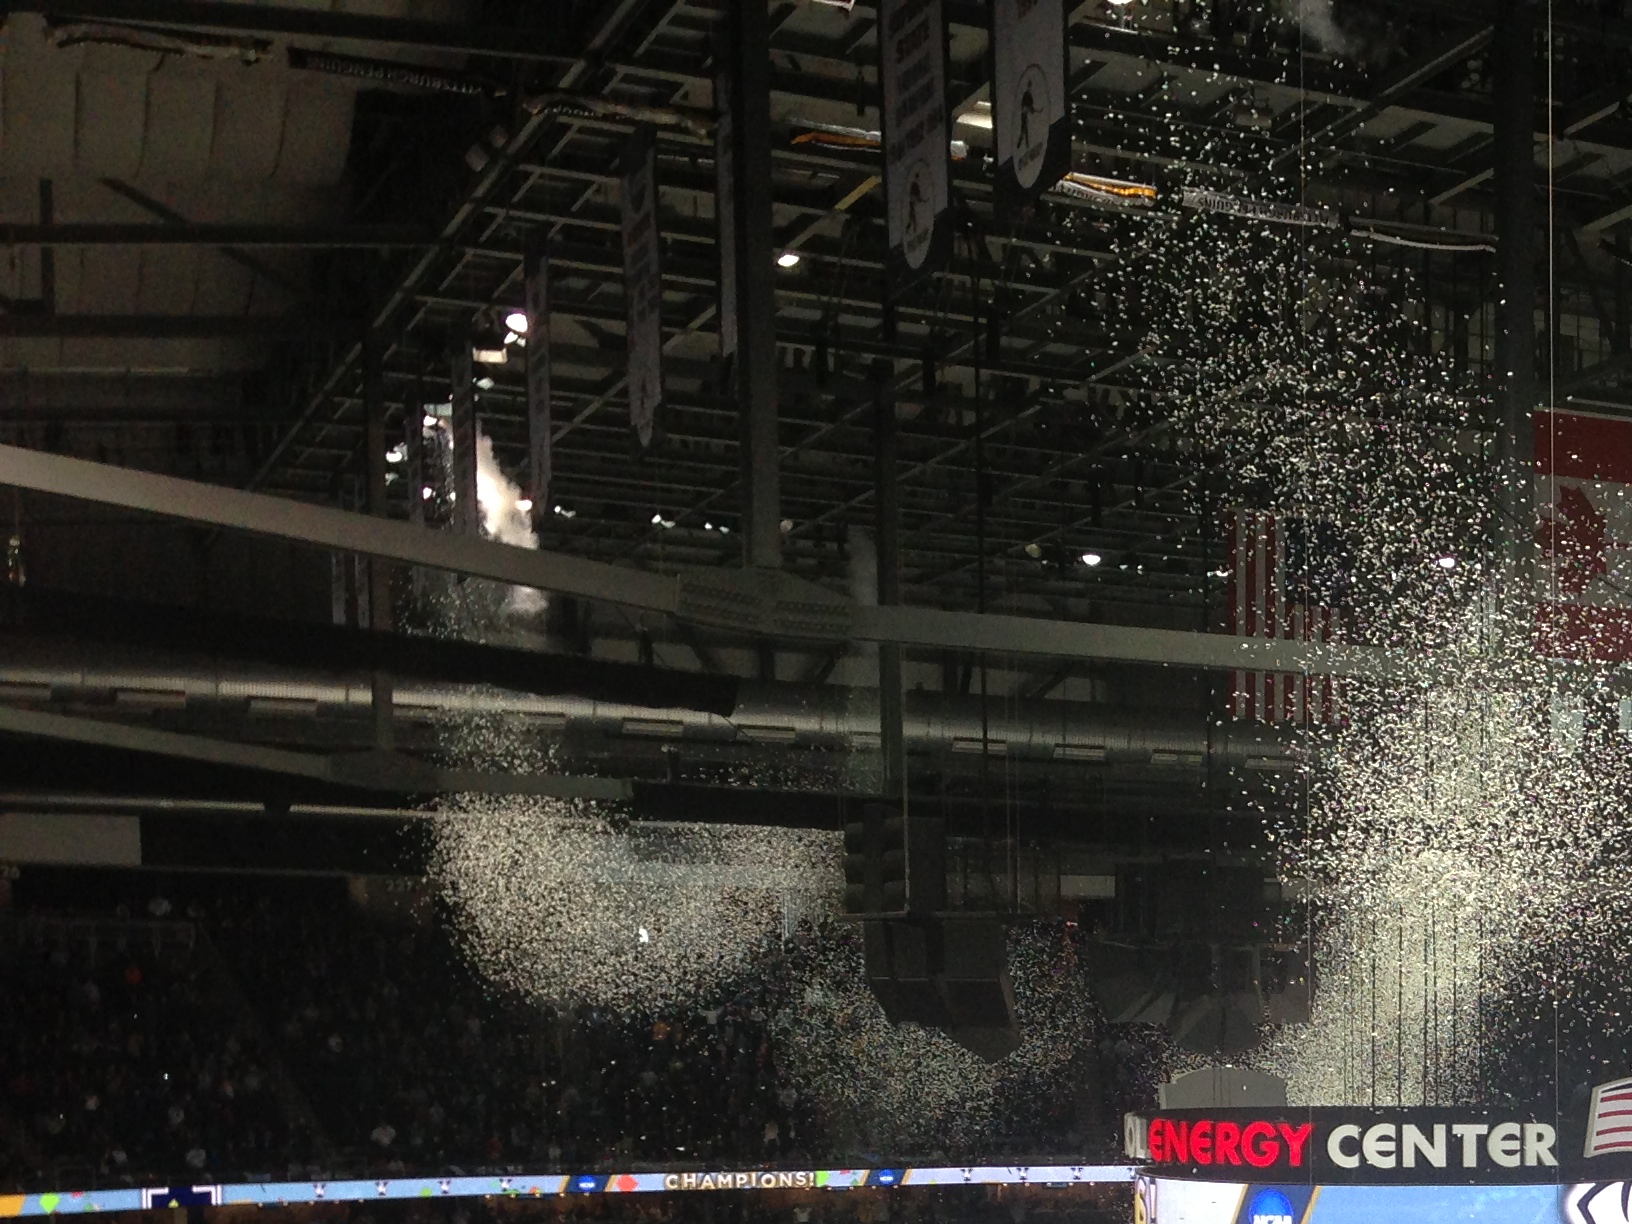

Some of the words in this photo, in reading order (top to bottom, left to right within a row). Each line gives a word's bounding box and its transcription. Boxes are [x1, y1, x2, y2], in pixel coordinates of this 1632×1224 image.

[1148, 1116, 1315, 1168] ENERGY
[1326, 1121, 1559, 1169] CENTER
[664, 1171, 815, 1190] CHAMPIONS!
